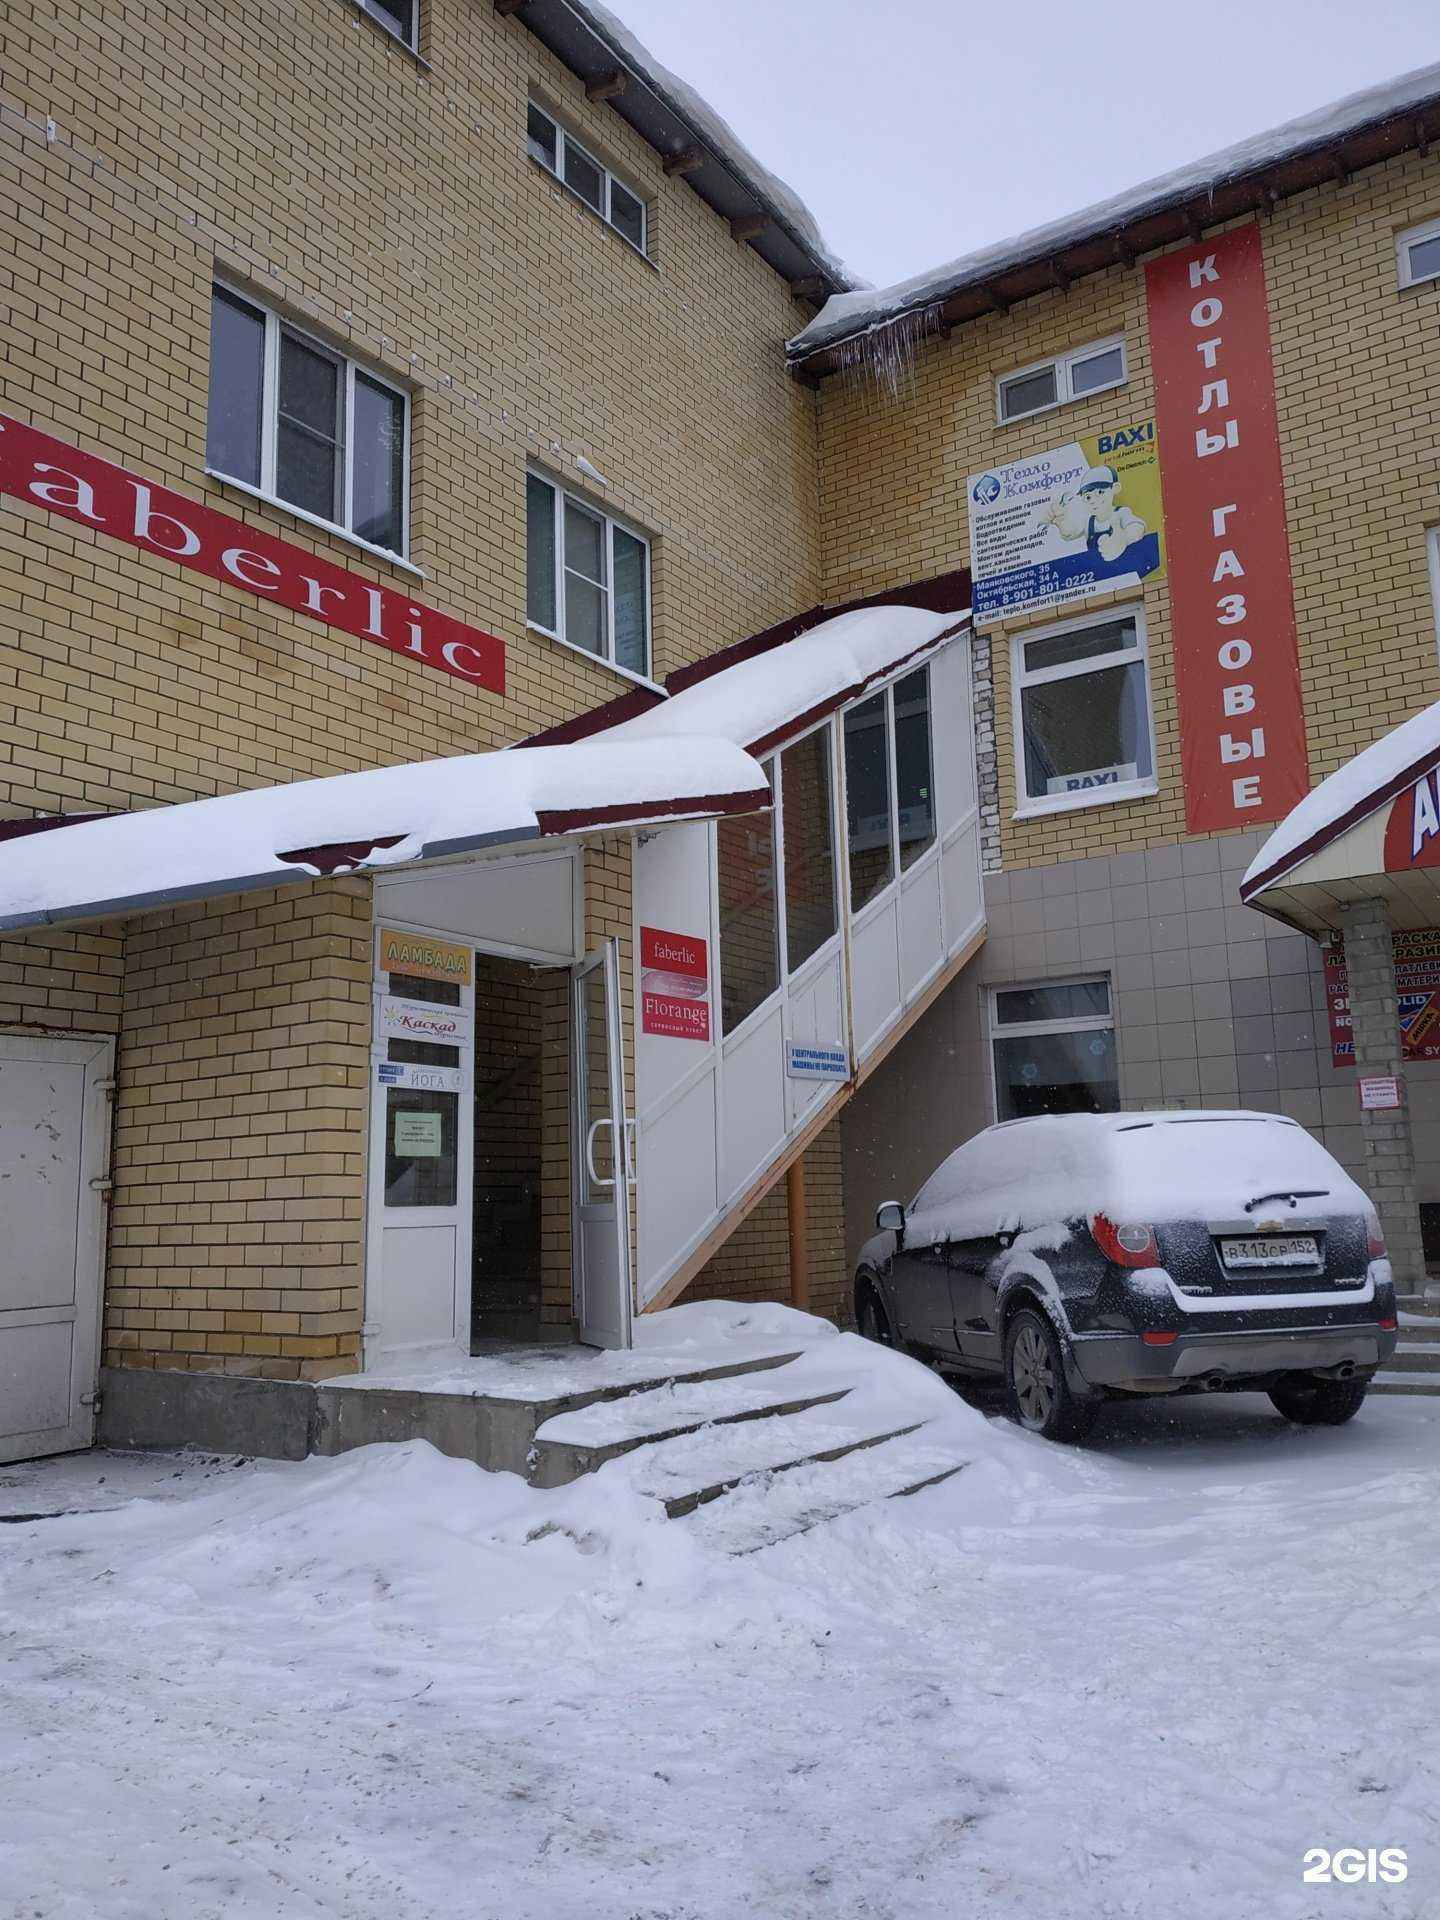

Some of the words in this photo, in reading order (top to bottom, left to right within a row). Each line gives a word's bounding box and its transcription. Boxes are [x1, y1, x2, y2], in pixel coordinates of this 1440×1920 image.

[1187, 253, 1240, 458] КОТЛЫ
[1098, 422, 1154, 455] BAXI
[1000, 462, 1051, 484] Тепло
[1003, 467, 1084, 499] Комфорт
[975, 505, 1022, 523] Обслуживание
[989, 534, 1007, 546] виды
[1029, 530, 1048, 543] работ
[0, 424, 482, 677] aberlic
[976, 569, 1037, 591] Маяковского,
[1039, 563, 1050, 574] 35
[977, 579, 1037, 600] Октябрьская,
[1039, 573, 1050, 584] 34
[977, 600, 999, 611] тел.
[1002, 571, 1095, 604] 8-901-801-0222
[1212, 504, 1266, 809] ГАЗОВЫЕ
[388, 941, 466, 973] ЛАМБАДА
[654, 942, 696, 964] faberlic
[399, 1014, 457, 1033] Каскад
[645, 998, 707, 1025] Florange
[411, 1070, 445, 1088] ЙОГА
